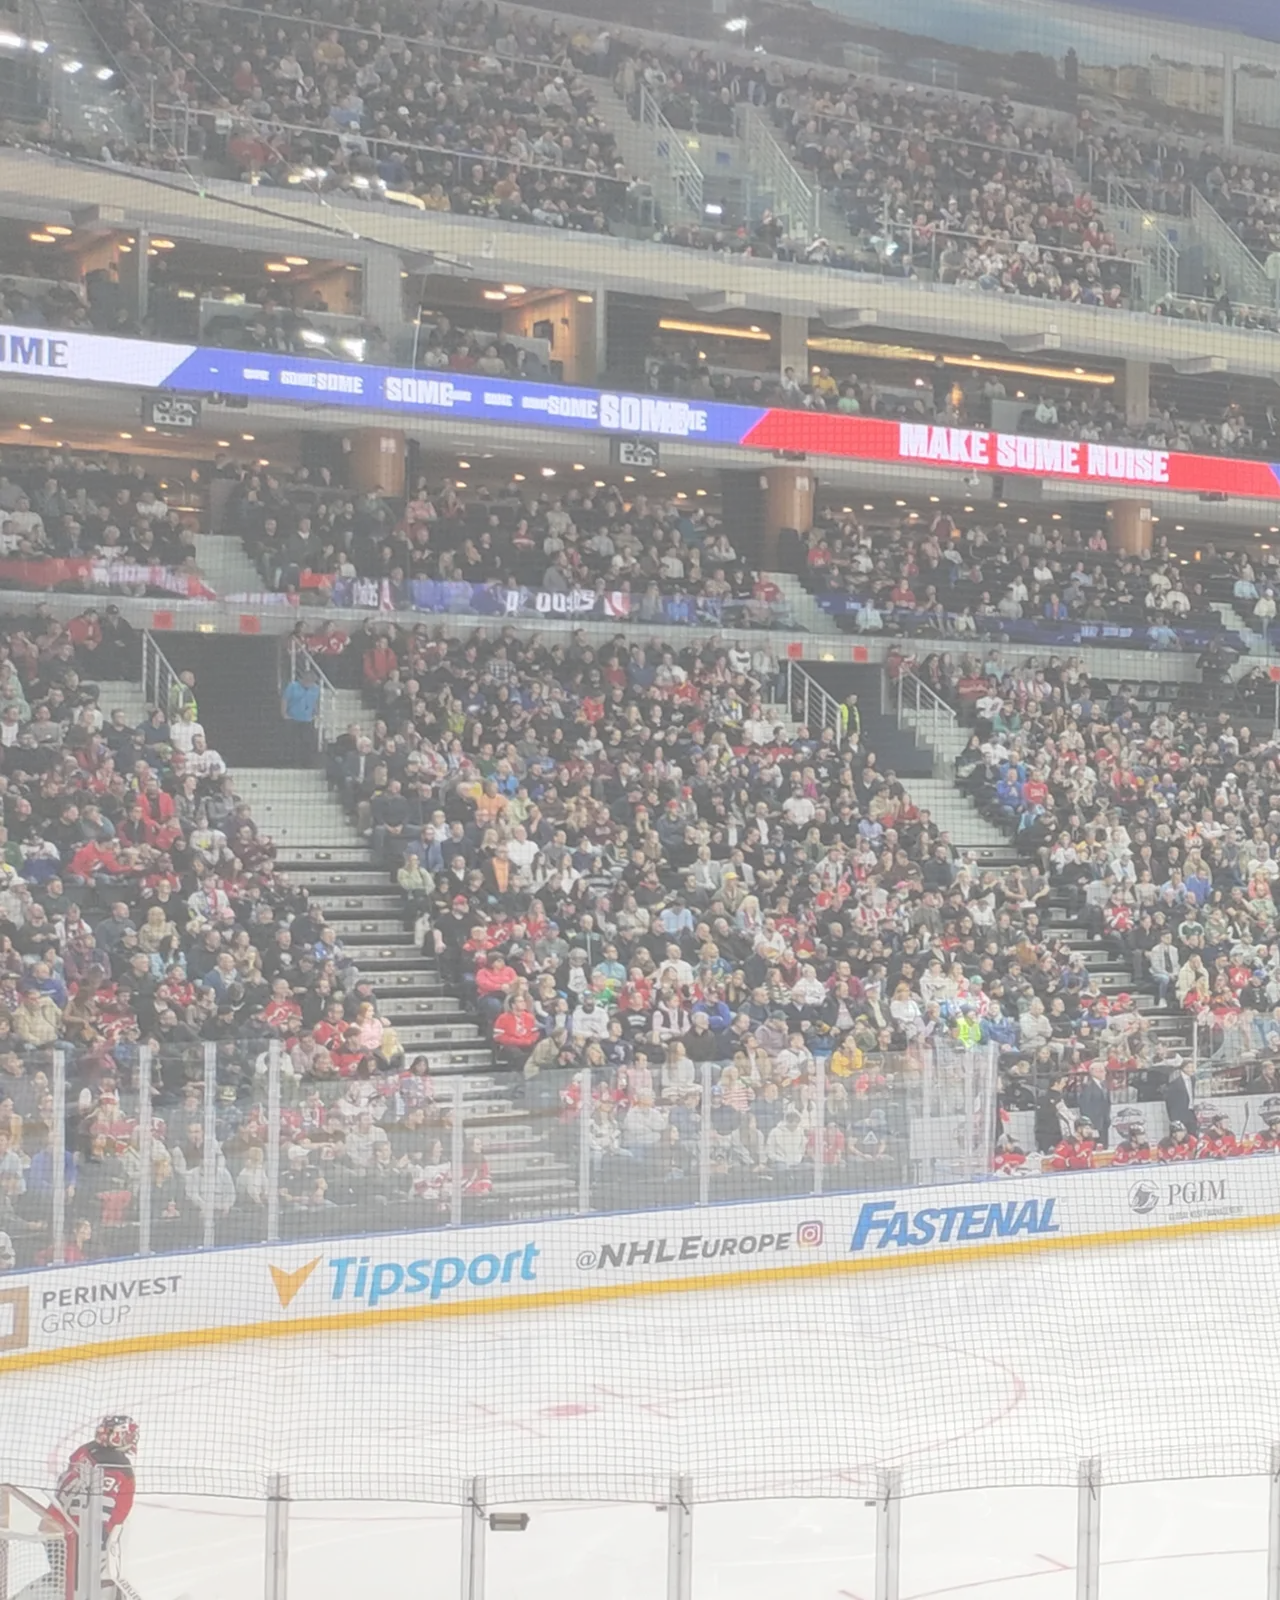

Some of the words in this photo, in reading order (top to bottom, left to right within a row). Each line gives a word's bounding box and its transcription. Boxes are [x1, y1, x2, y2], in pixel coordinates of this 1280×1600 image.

[0, 334, 69, 368] ME
[899, 422, 989, 465] MAKE
[996, 432, 1080, 475] SOME
[1087, 442, 1170, 483] NOISE
[1168, 1179, 1226, 1206] PGIM
[848, 1197, 1061, 1253] FASTENAL
[328, 1240, 541, 1307] Tipsport
[41, 1274, 182, 1310] PERINVEST
[41, 1304, 132, 1334] GROUP
